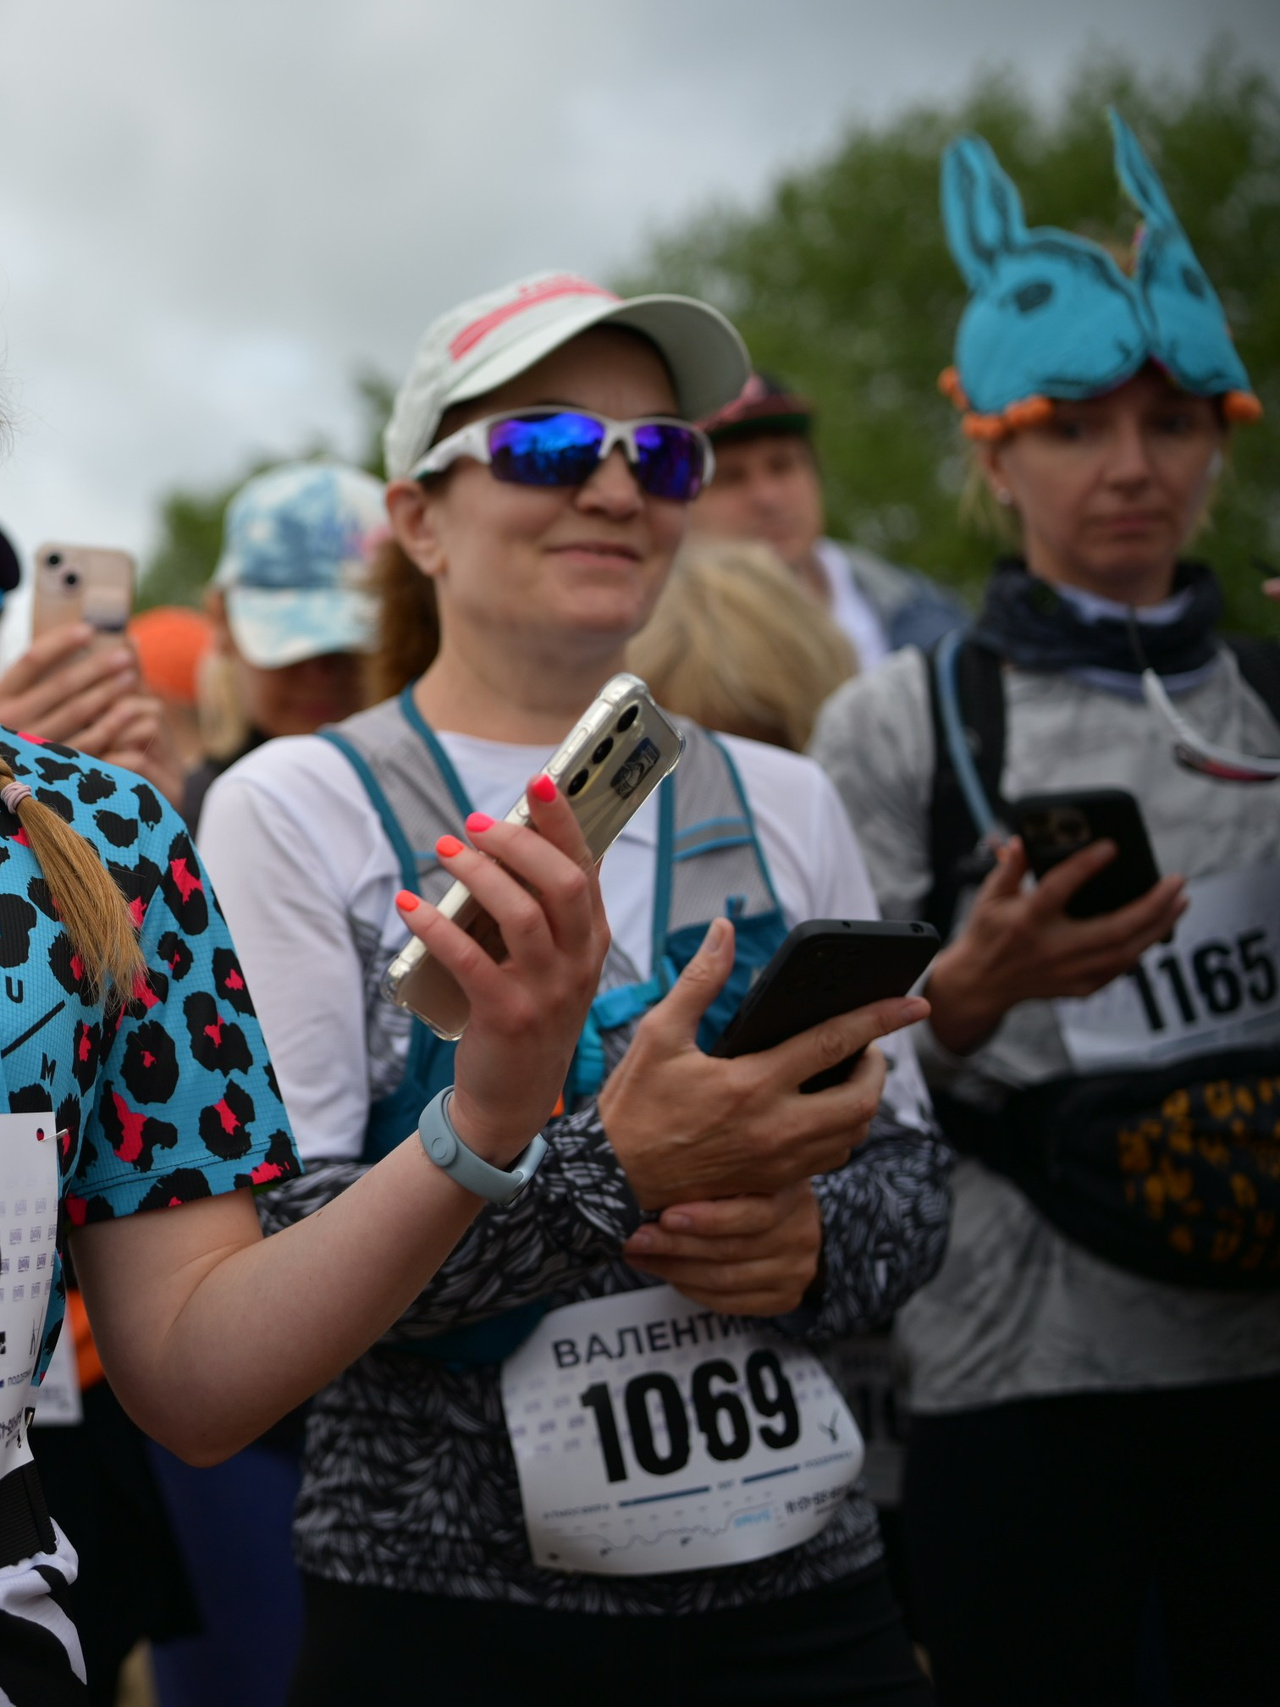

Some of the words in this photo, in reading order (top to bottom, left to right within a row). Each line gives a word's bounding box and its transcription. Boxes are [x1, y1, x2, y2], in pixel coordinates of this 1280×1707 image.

[1127, 928, 1277, 1030] 1165
[553, 1311, 766, 1369] ВАЛЕНТИ
[578, 1347, 801, 1484] 1069
